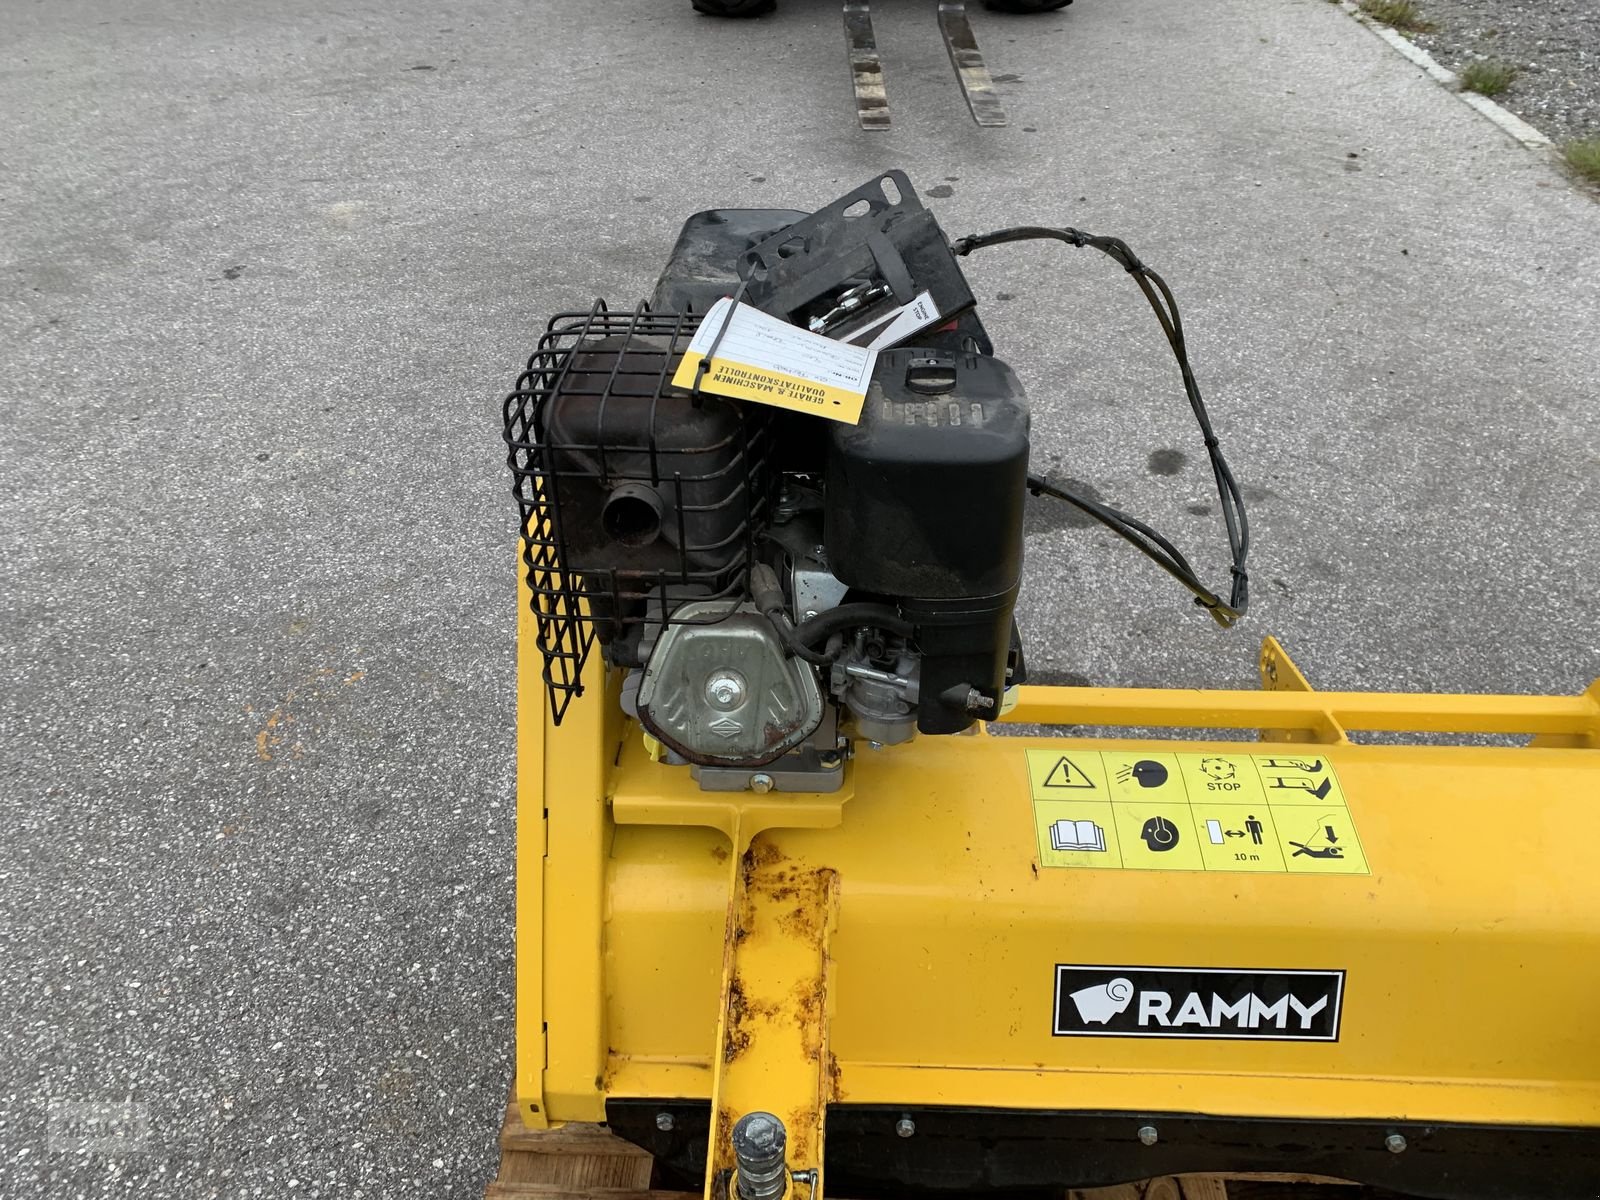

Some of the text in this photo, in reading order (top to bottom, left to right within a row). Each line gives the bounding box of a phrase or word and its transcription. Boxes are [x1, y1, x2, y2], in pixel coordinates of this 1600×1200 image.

[913, 307, 922, 320] STOP
[917, 301, 929, 320] ENGINE
[713, 373, 774, 393] MASCHINEN
[1207, 782, 1241, 791] STOP
[1234, 853, 1247, 861] 10
[1138, 990, 1328, 1029] RAMMY
